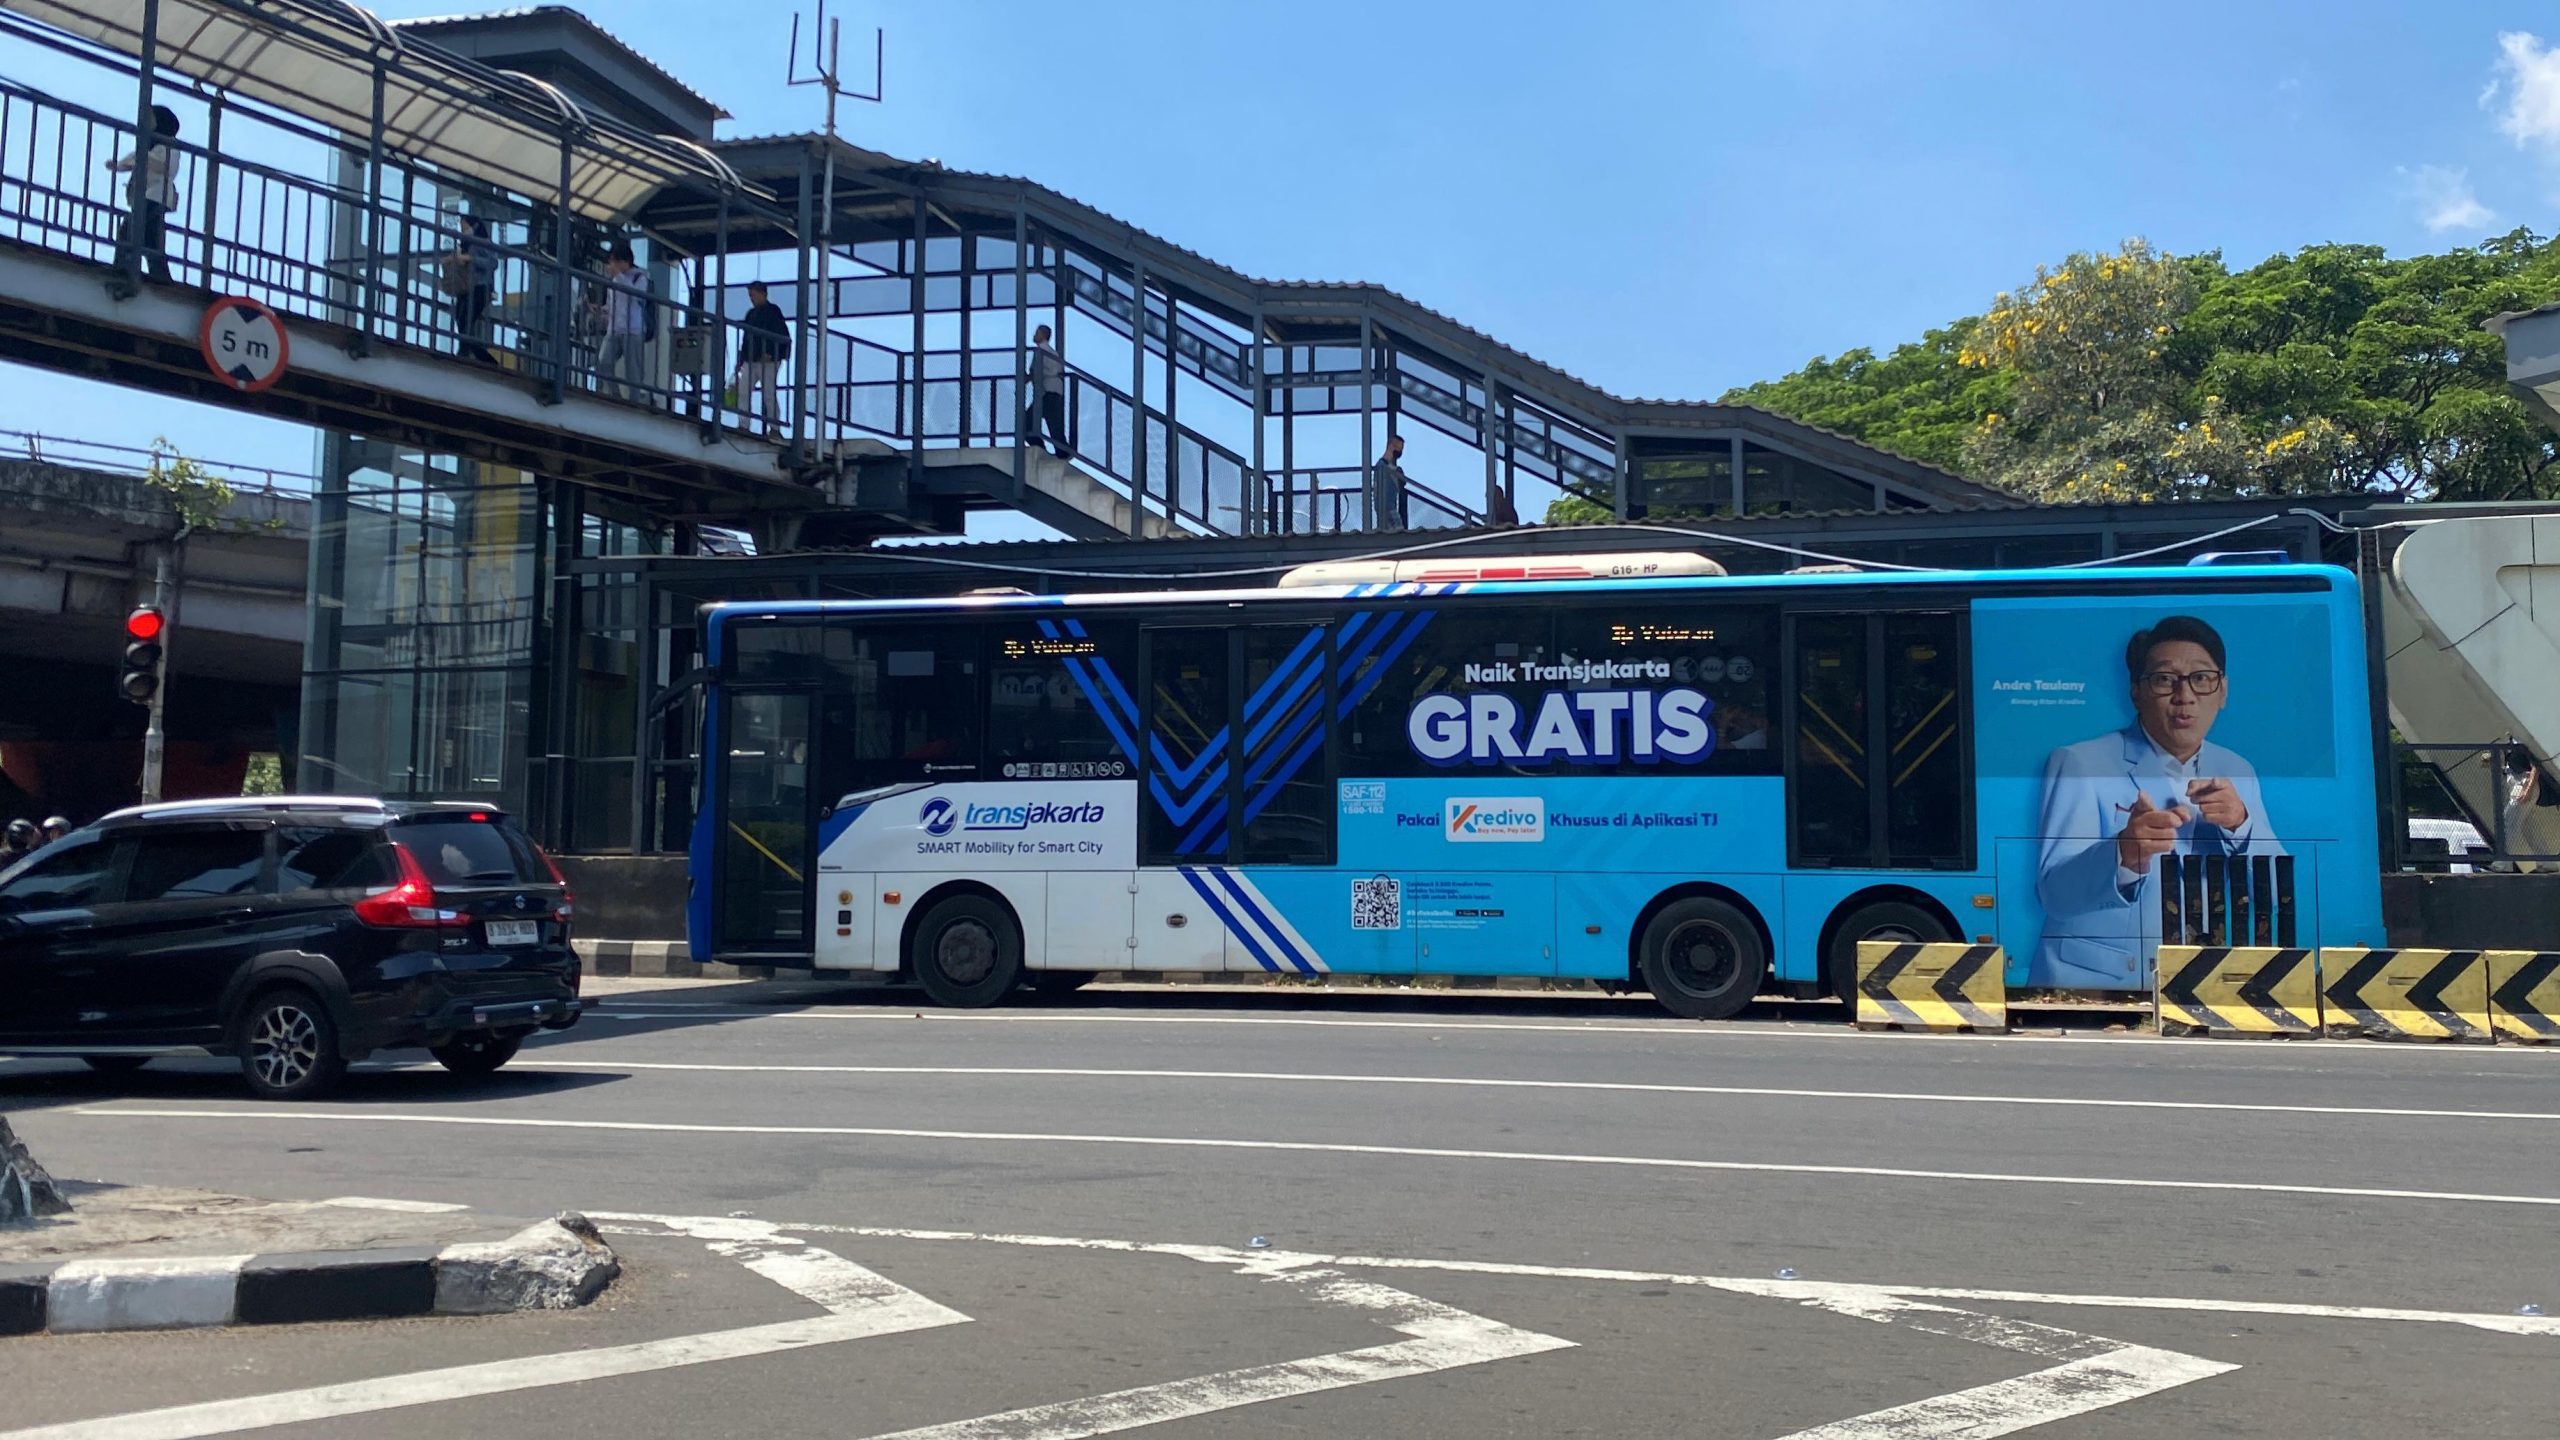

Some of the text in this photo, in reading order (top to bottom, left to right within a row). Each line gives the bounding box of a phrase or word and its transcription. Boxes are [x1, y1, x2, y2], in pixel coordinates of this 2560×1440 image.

[222, 330, 269, 359] 5 m
[1464, 660, 1670, 684] Naik Transjakarta
[1992, 679, 2086, 693] Andre Taulany
[1407, 688, 1711, 761] GRATIS
[964, 802, 1105, 830] transjakarta
[1397, 805, 1718, 833] Pakai Kredivo Khusus di Aplikasi TJ
[917, 841, 1103, 856] SMART Mobility for Smart City
